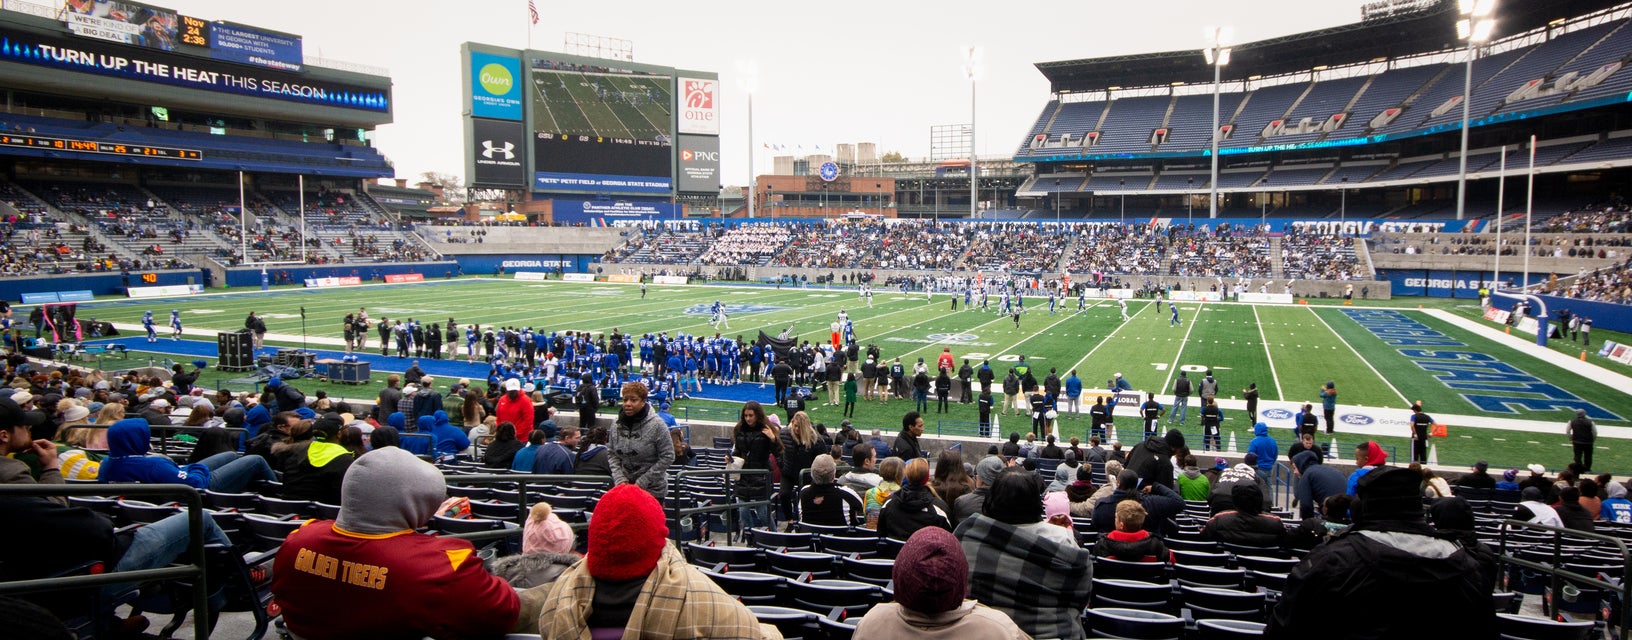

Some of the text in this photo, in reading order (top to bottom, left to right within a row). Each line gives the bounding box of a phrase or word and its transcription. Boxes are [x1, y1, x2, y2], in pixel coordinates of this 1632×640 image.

[74, 15, 138, 33] WE'RE KIND OF
[184, 17, 205, 28] Nov
[83, 28, 98, 36] BIG
[99, 31, 123, 41] DEAL
[187, 26, 201, 36] 24
[218, 27, 294, 46] THE LARGEST UNIVERSITY
[183, 34, 206, 45] 2:38
[226, 35, 253, 44] GEORGIA
[218, 40, 276, 55] 50,000+ STUDENTS
[249, 56, 301, 71] #thestateway
[39, 44, 325, 99] TURN UP THE HEAT THIS SEASON
[481, 72, 511, 87] Own
[685, 110, 713, 121] one
[71, 141, 97, 151] 14:49
[114, 145, 127, 154] 25
[694, 151, 719, 162] PNC
[502, 260, 572, 268] GEORGIA STATE
[142, 273, 157, 283] 40
[1404, 278, 1467, 289] GEORGIA
[1395, 348, 1630, 422] STATE
[1389, 418, 1411, 427] Furthe
[294, 547, 389, 590] GOLDEN TIGERS
